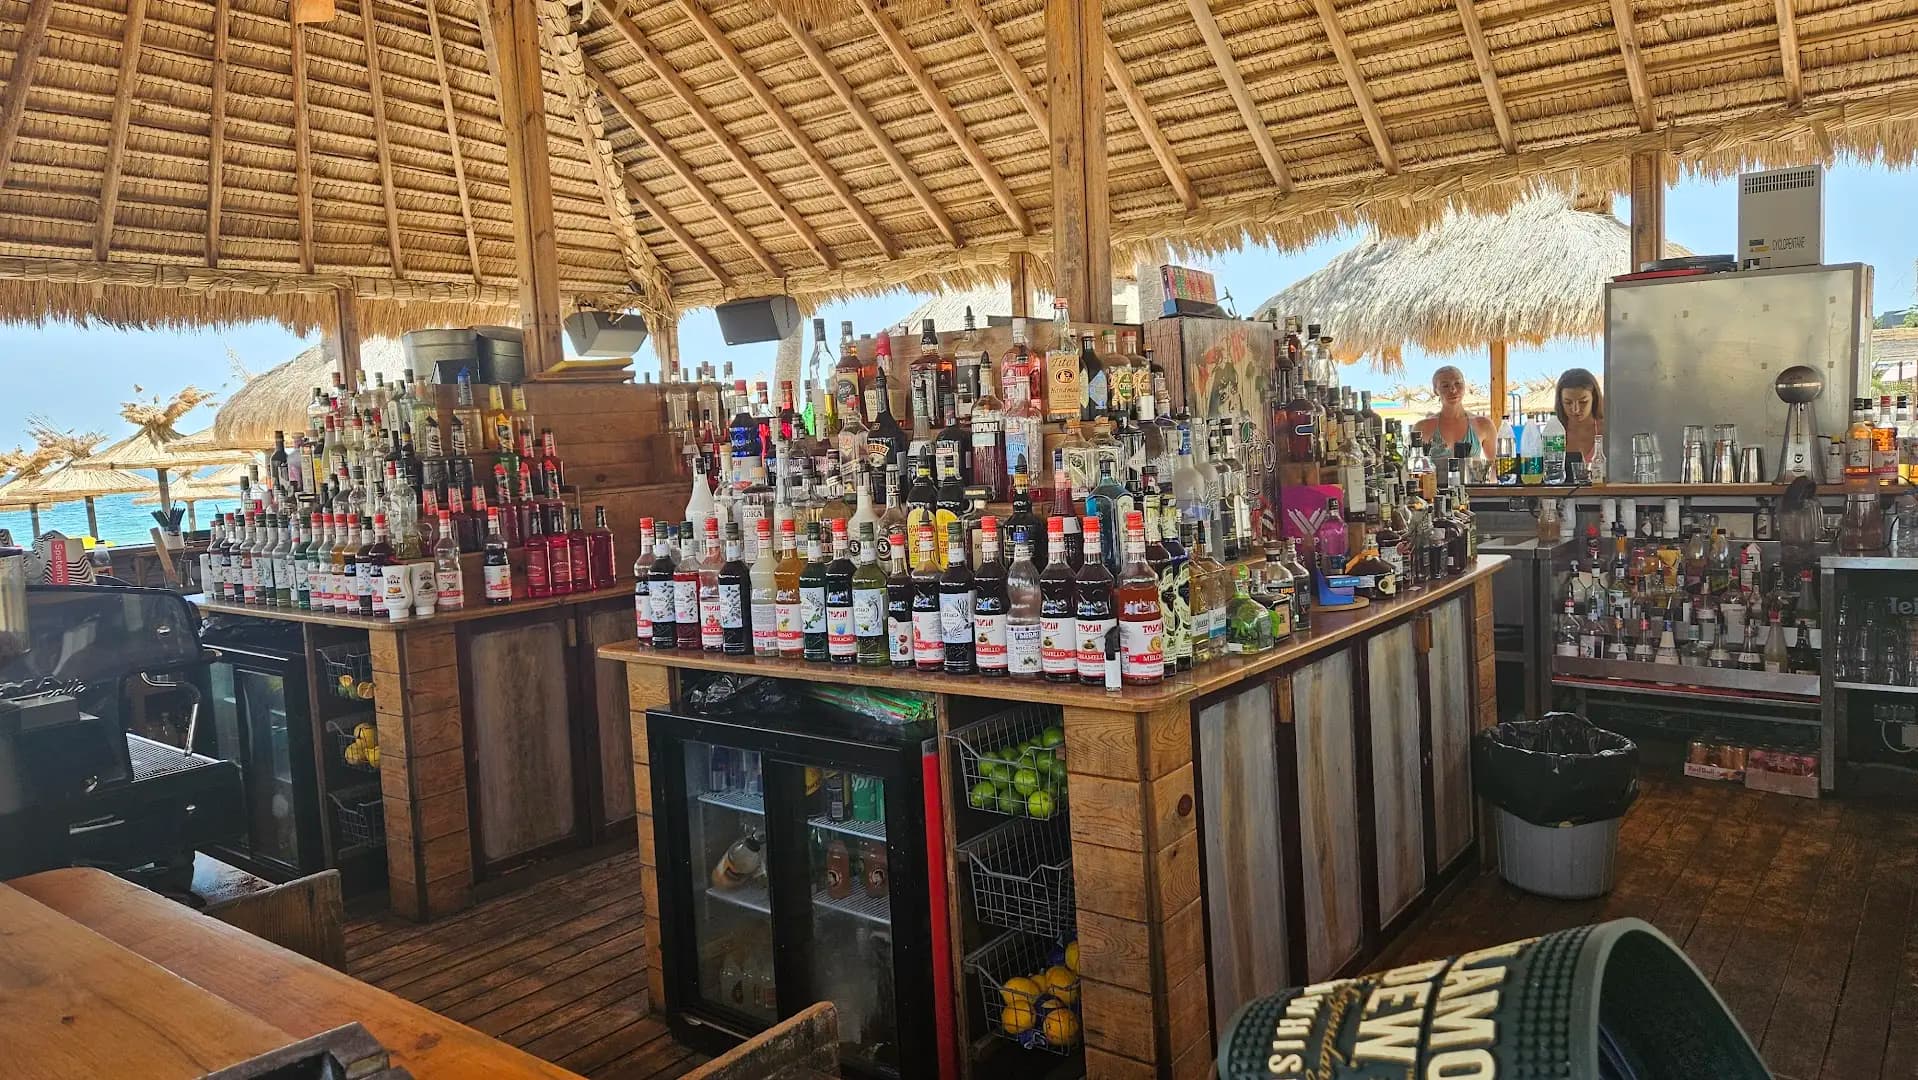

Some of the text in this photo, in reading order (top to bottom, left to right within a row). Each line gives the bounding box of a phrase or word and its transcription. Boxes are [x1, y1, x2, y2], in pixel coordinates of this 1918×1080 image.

[1077, 623, 1102, 633] TOSCHI
[1268, 995, 1323, 1080] WHIS
[1354, 959, 1448, 1065] DEW
